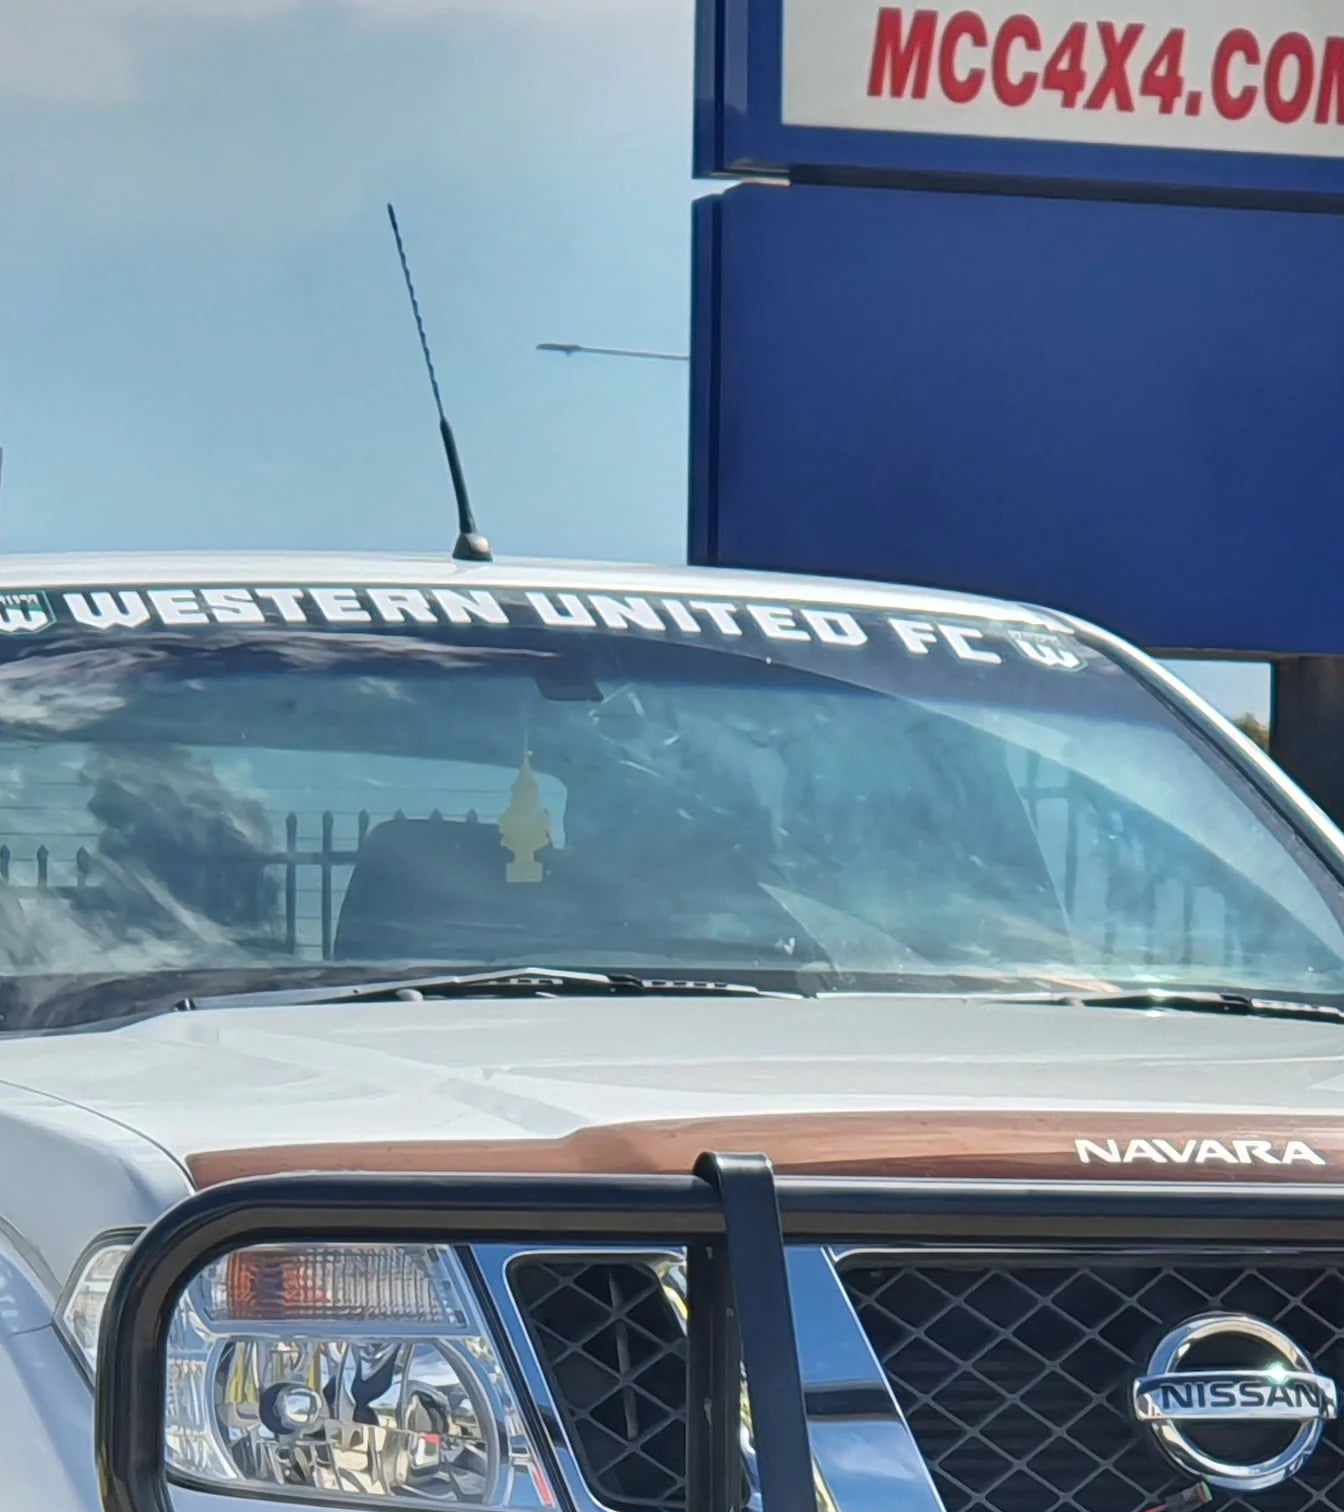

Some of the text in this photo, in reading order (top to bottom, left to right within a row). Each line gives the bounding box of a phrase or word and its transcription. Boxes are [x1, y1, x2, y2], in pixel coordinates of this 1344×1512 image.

[62, 587, 1003, 665] WESTERN UNITED FC
[1074, 1138, 1327, 1166] NAVARA
[1160, 1381, 1321, 1410] NISSAN
